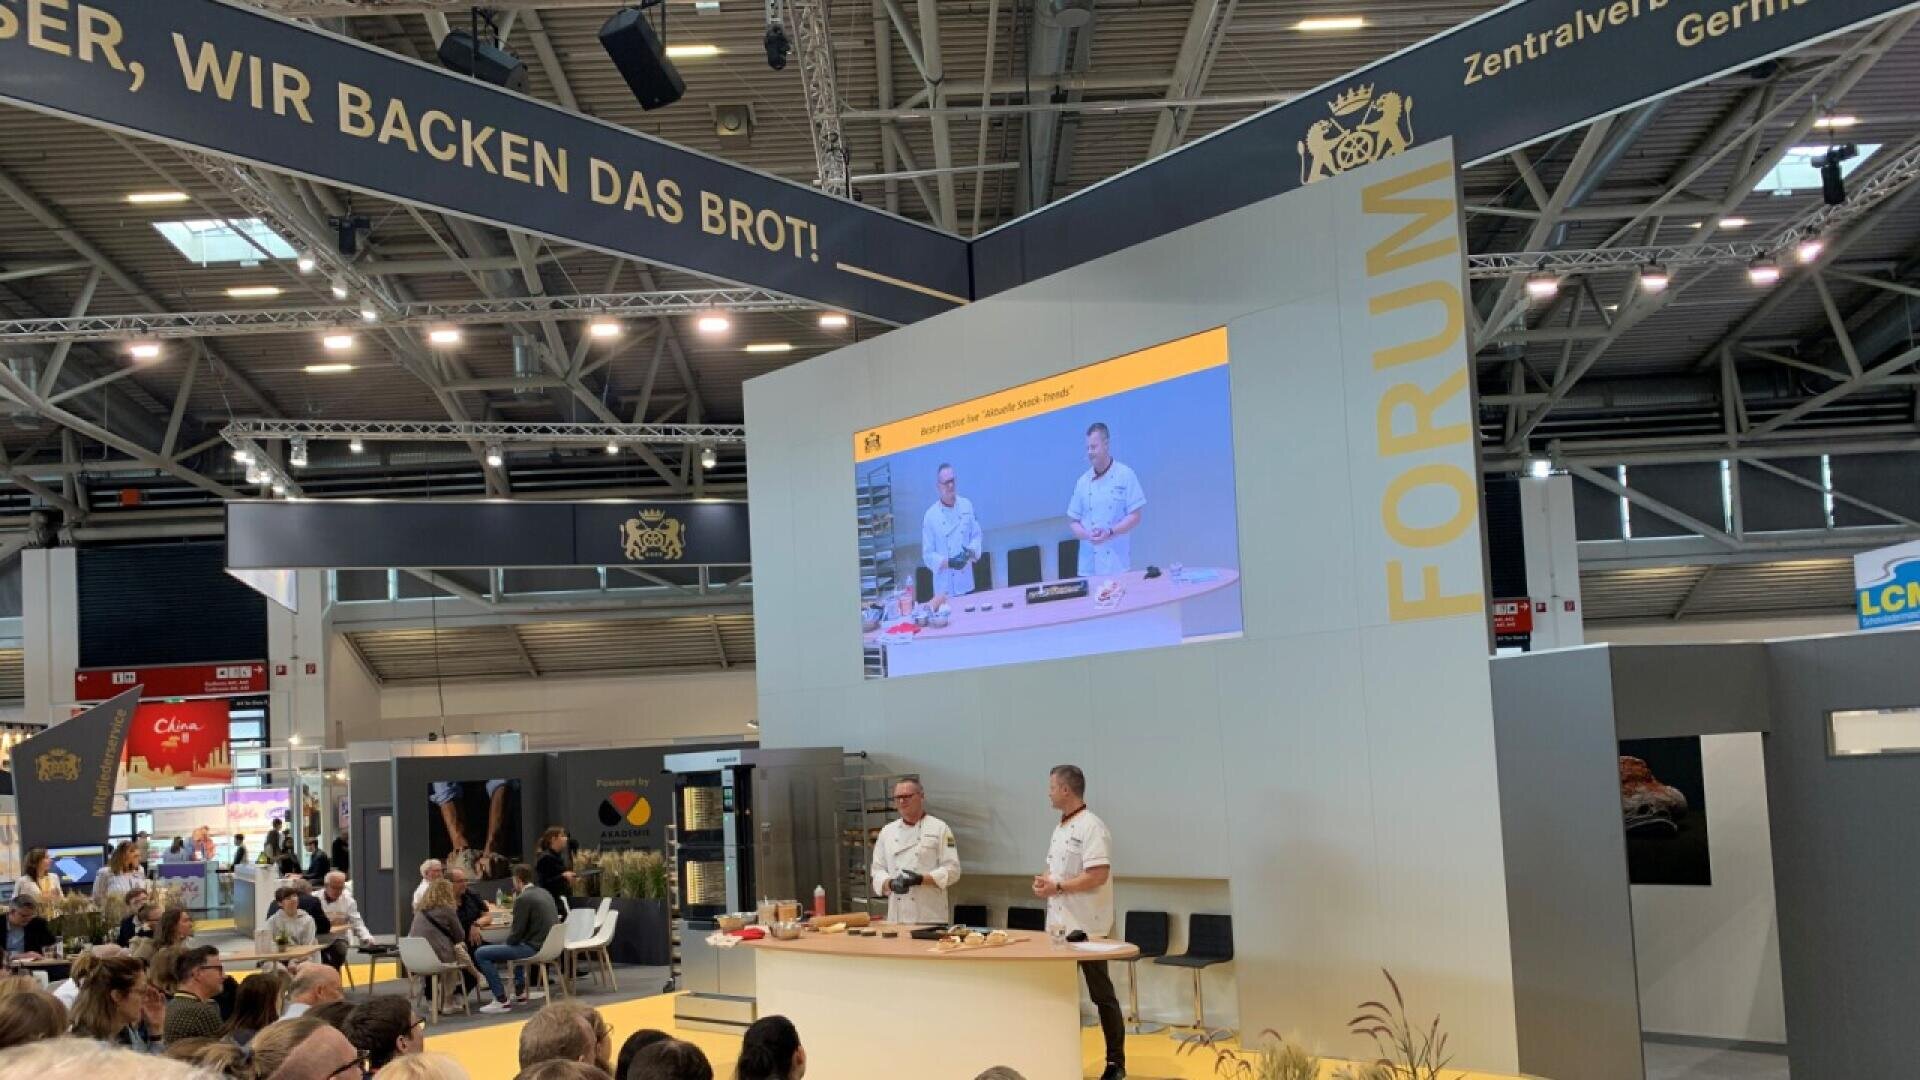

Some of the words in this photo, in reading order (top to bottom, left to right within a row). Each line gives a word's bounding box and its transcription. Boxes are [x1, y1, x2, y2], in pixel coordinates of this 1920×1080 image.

[1676, 0, 1807, 47] Germ
[171, 32, 313, 123] WIR
[338, 82, 568, 193] BACKEN
[590, 157, 684, 225] DAS
[701, 190, 819, 262] BROT!
[1361, 159, 1485, 622] FORUM
[154, 715, 204, 734] China
[91, 707, 128, 817] Mitgliederservice
[596, 778, 635, 788] Powered
[638, 777, 649, 788] by
[601, 829, 650, 838] AKADEMIE
